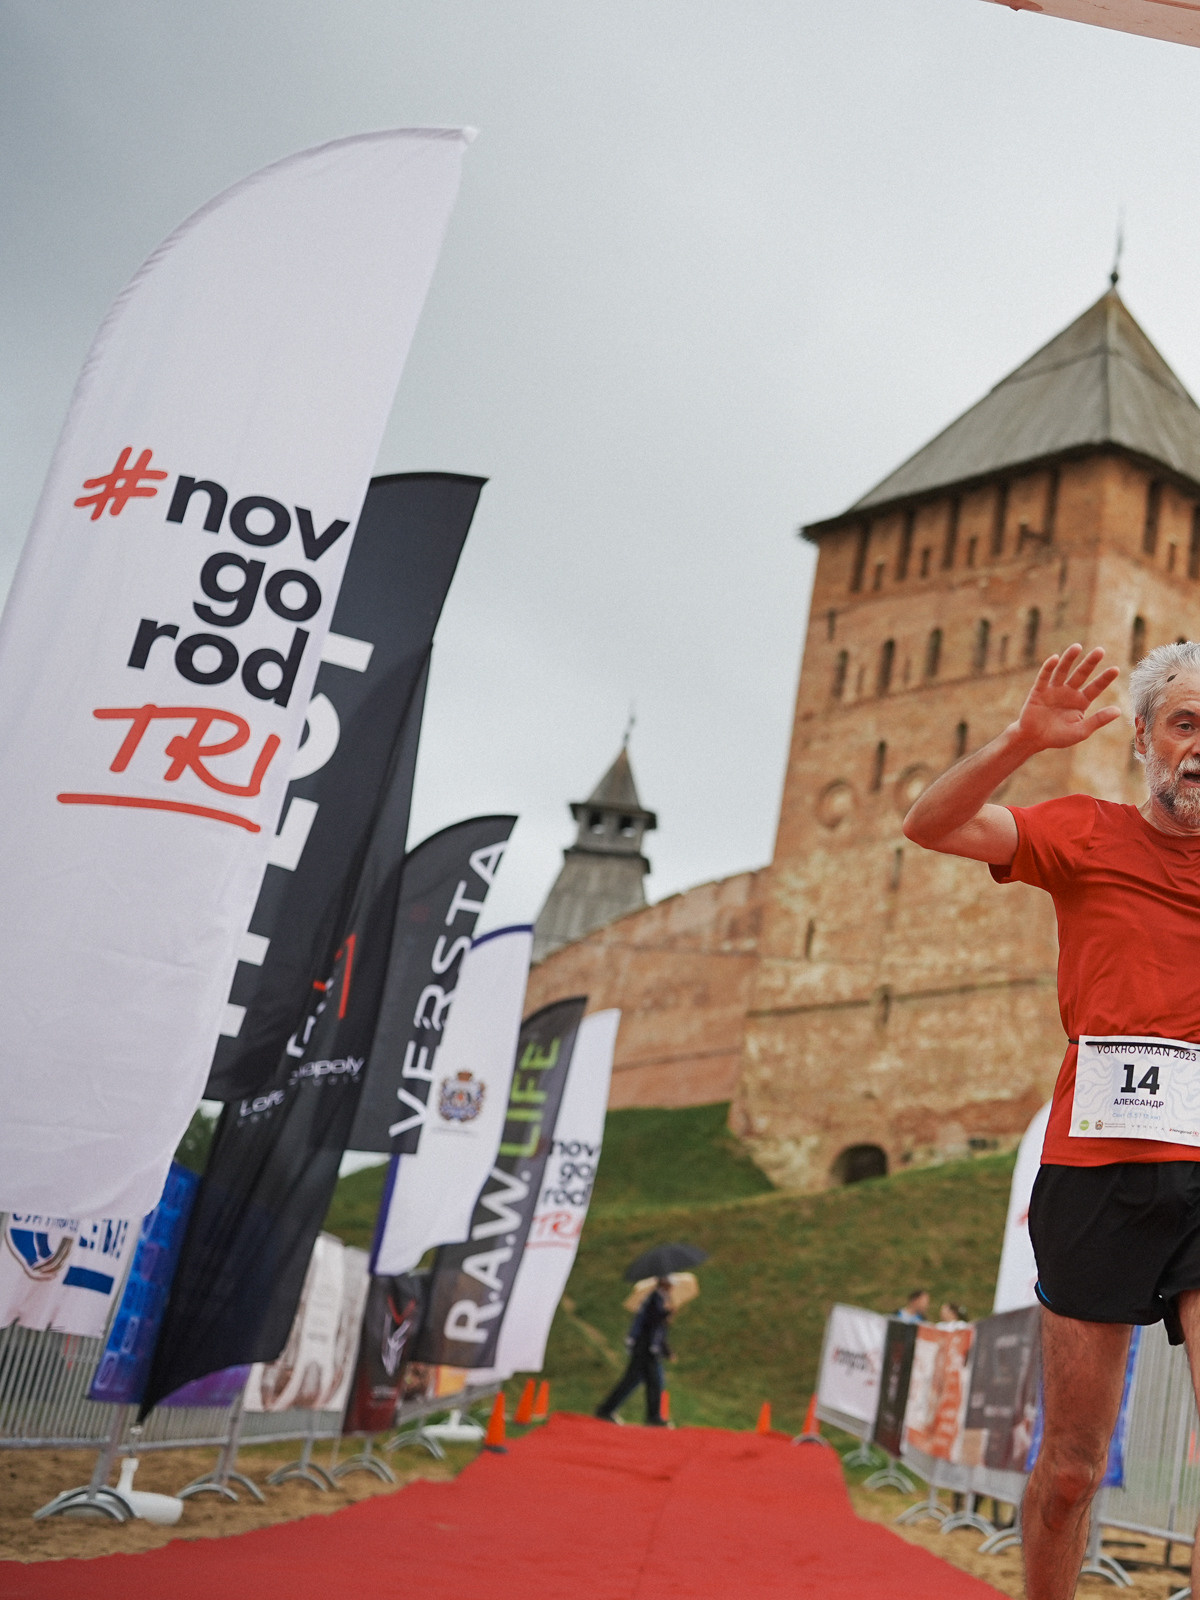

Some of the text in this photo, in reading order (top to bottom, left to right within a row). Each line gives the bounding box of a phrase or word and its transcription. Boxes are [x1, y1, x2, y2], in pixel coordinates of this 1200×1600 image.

[74, 446, 350, 562] #nov
[193, 551, 323, 628] go
[127, 617, 311, 709] rod
[93, 703, 281, 798] TRI
[1096, 1044, 1198, 1062] VOLKHOVMAN 2023
[1120, 1064, 1160, 1095] 14
[500, 1036, 561, 1158] LIFE
[1113, 1098, 1164, 1109] АЛЕКСАНДР
